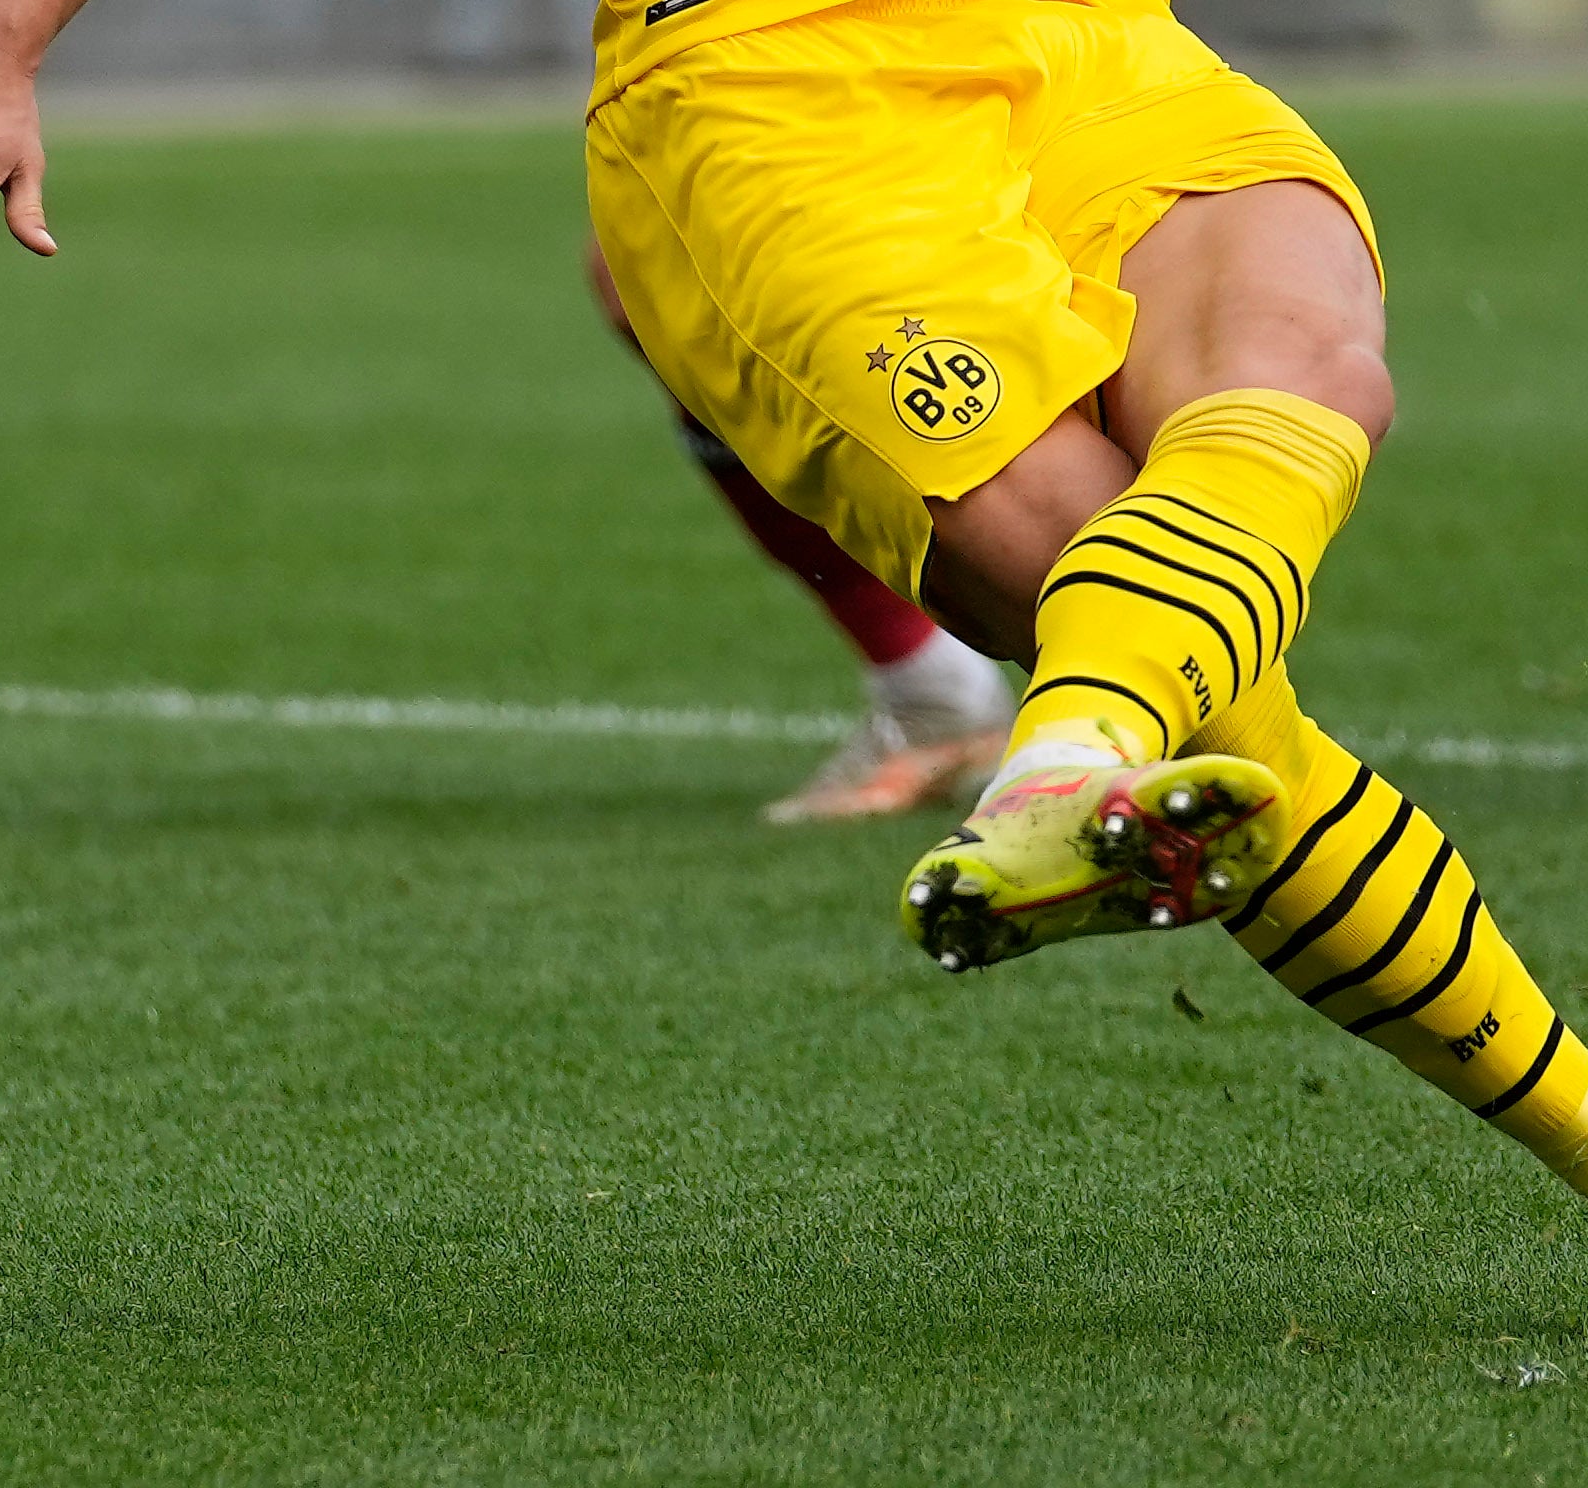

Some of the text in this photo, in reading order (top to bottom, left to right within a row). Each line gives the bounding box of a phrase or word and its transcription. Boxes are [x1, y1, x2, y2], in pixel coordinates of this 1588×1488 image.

[904, 349, 986, 429] BVB
[952, 395, 983, 425] 09
[1178, 654, 1212, 722] BVB
[1448, 1009, 1501, 1063] BVB
